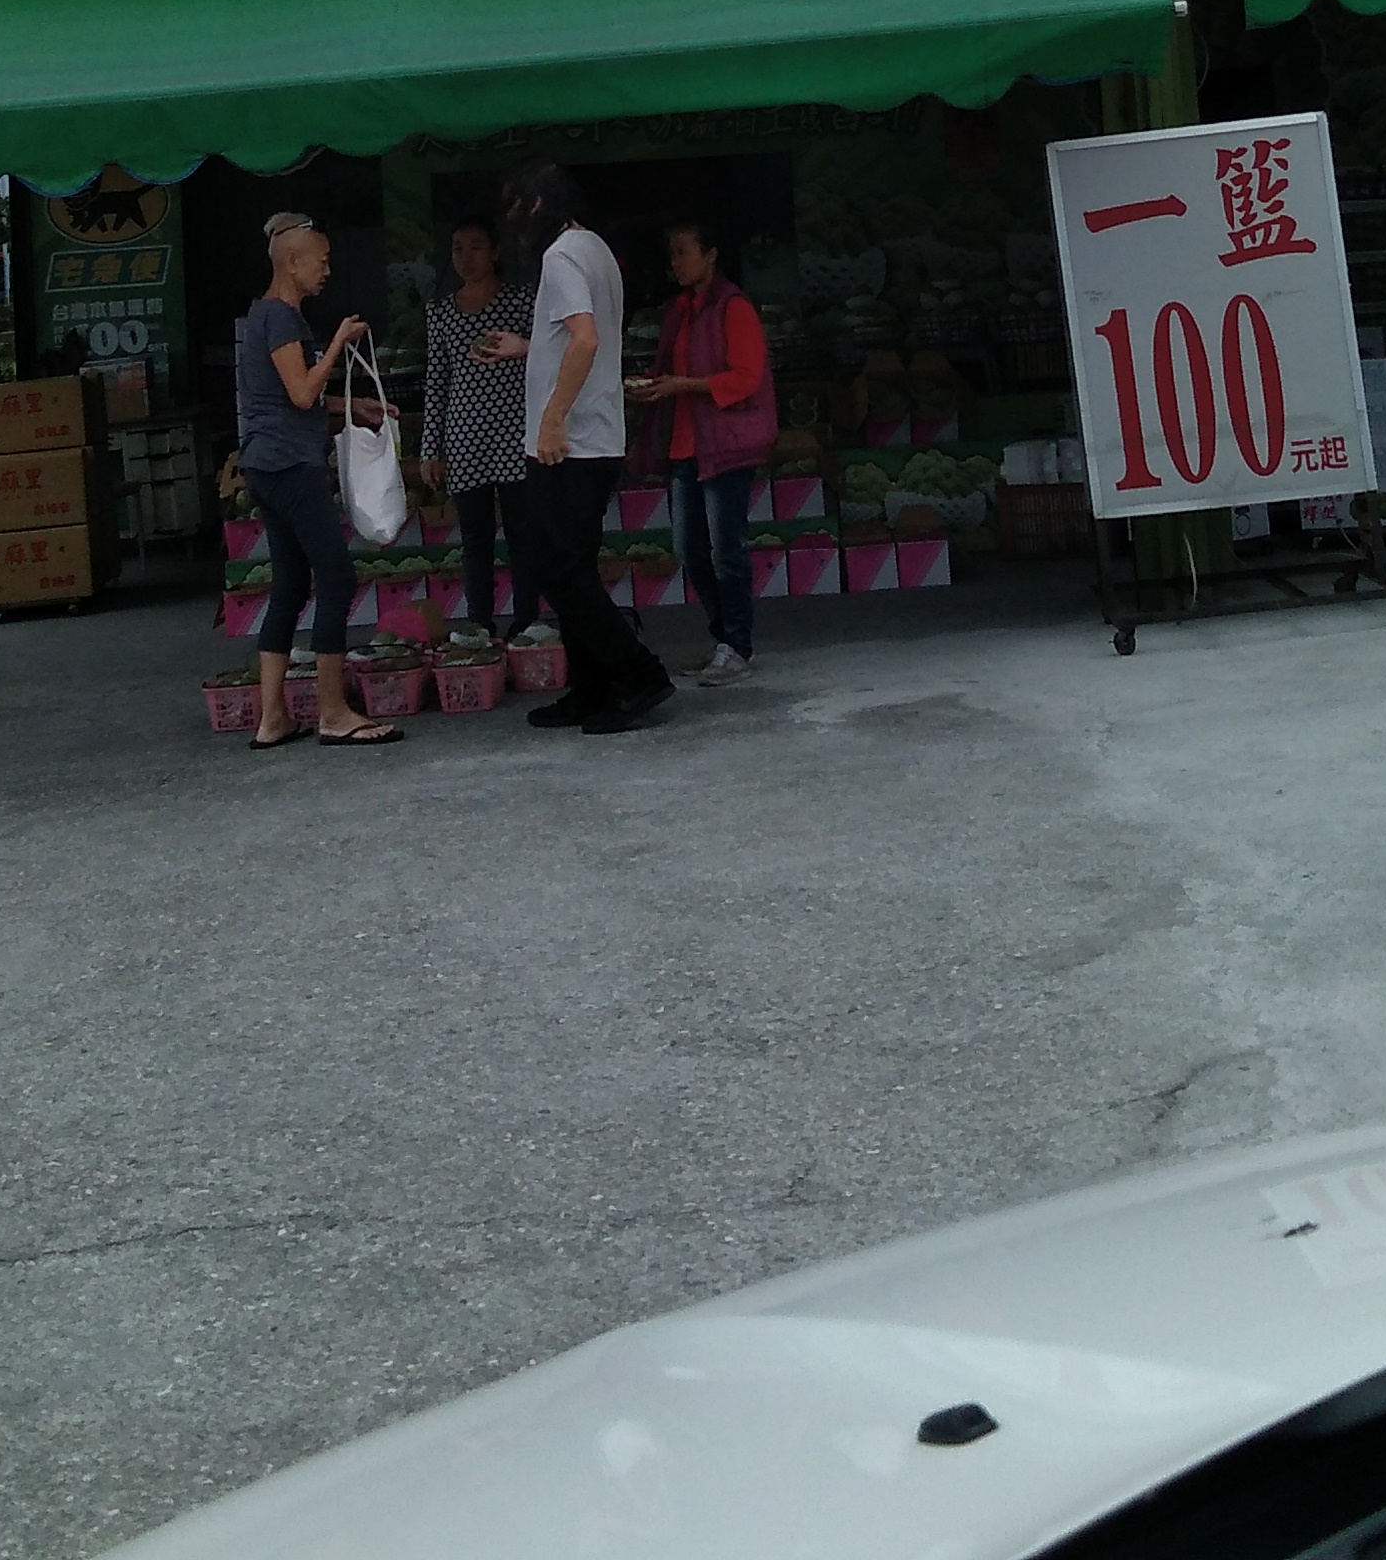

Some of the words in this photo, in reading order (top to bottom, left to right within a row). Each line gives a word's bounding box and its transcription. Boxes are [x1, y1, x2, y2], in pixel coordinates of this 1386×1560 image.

[1083, 137, 1317, 266] 一籃
[1095, 293, 1287, 492] 100
[1290, 436, 1349, 474] 元起
